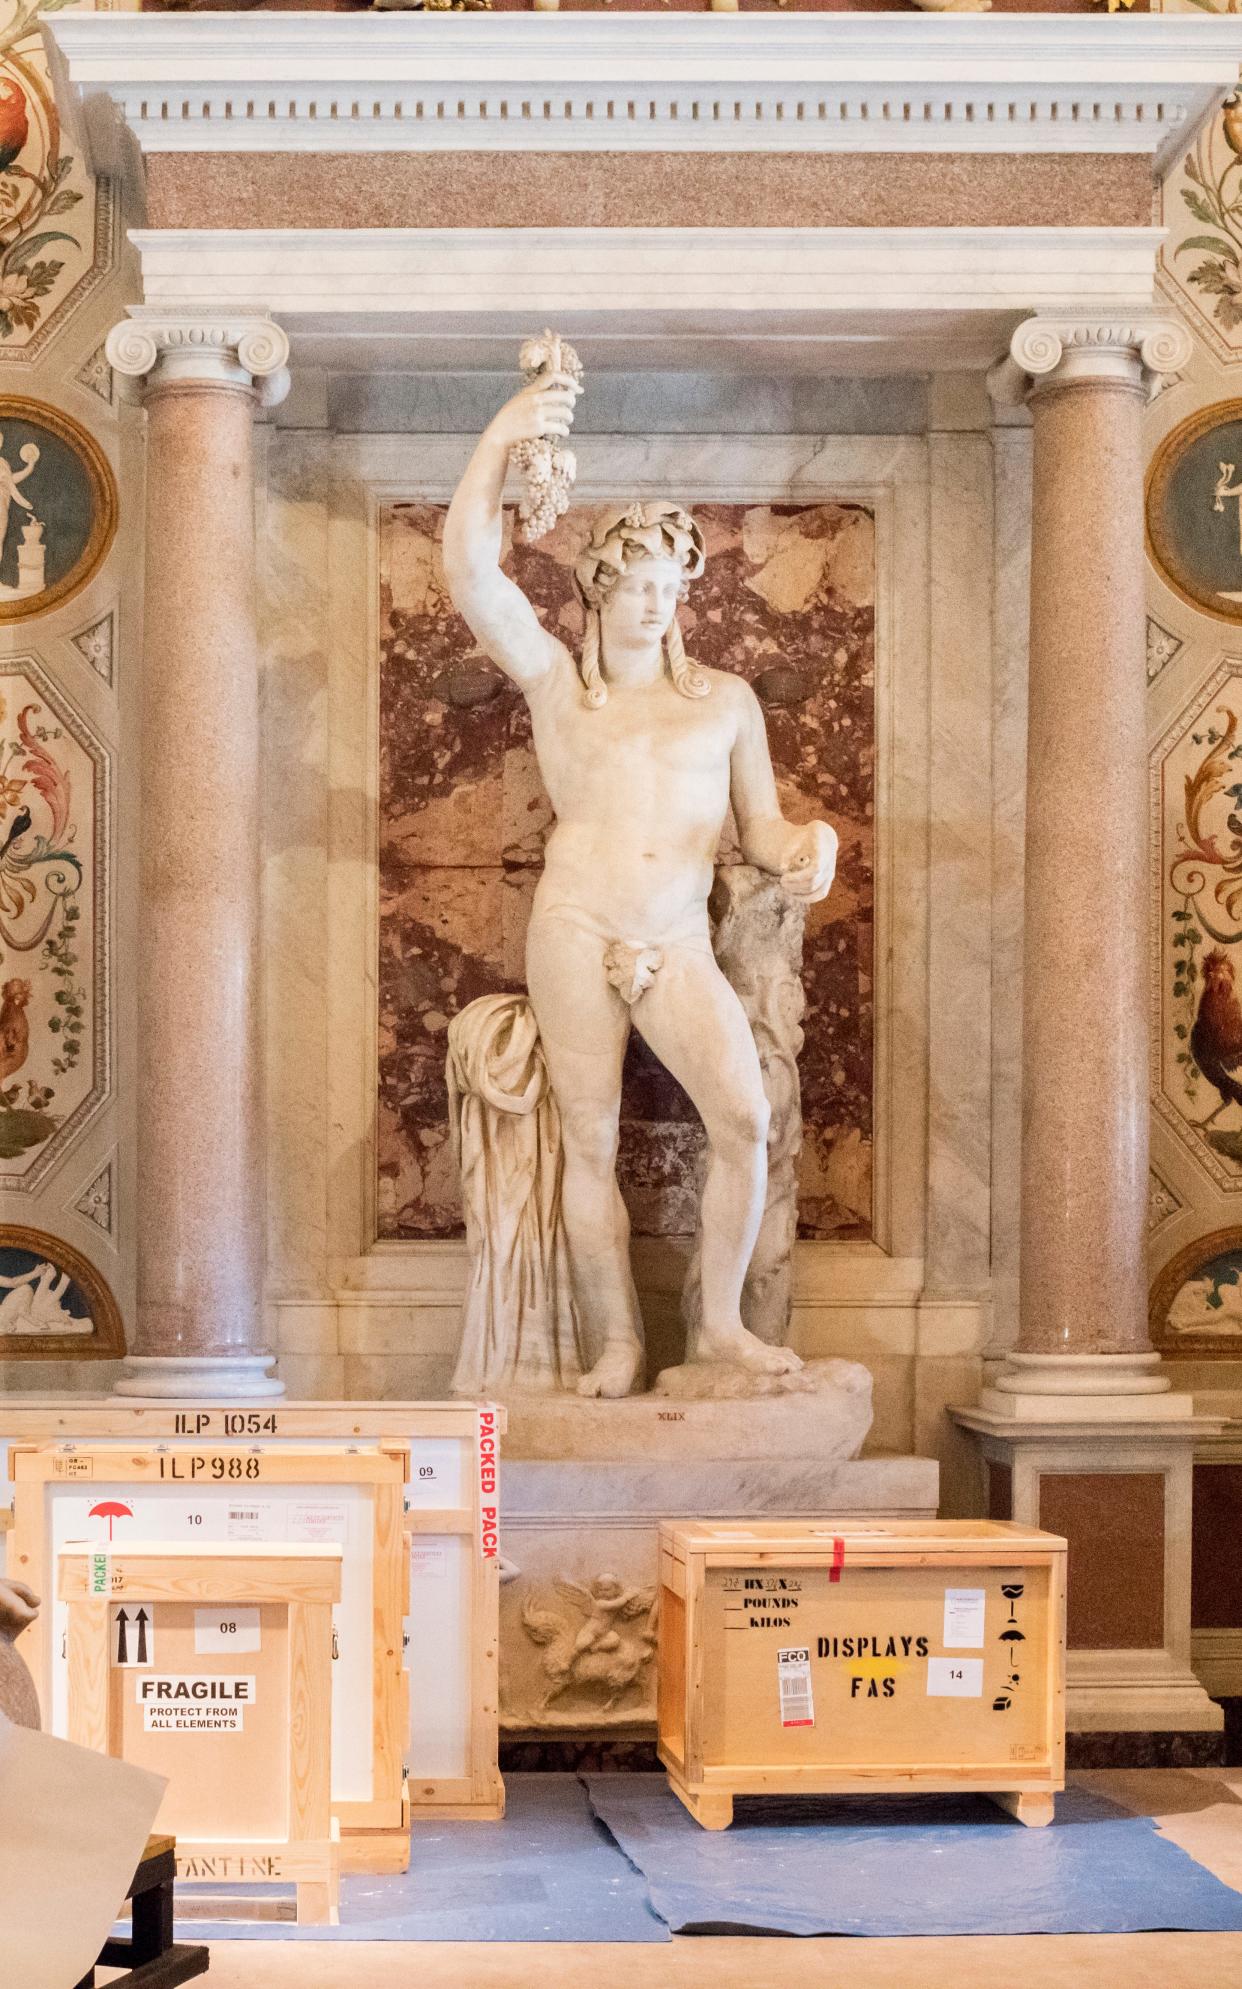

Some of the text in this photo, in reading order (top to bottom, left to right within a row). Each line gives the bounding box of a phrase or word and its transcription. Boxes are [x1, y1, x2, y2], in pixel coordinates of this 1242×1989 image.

[657, 1412, 686, 1421] XLIX
[175, 1414, 277, 1434] ILP 1054
[479, 1412, 496, 1494] PACKED
[419, 1466, 434, 1477] 09
[187, 1514, 203, 1525] 10
[743, 1598, 799, 1609] POUNDS
[219, 1622, 237, 1634] 08
[750, 1617, 791, 1628] KILOS
[817, 1636, 929, 1658] DISPLAYS
[779, 1651, 806, 1663] FCO
[950, 1670, 963, 1680] 14
[142, 1681, 249, 1699] FRAGILE
[851, 1677, 896, 1698] FAS
[149, 1707, 238, 1717] PROTECT FROM
[151, 1719, 237, 1728] ALL ELEMENTS
